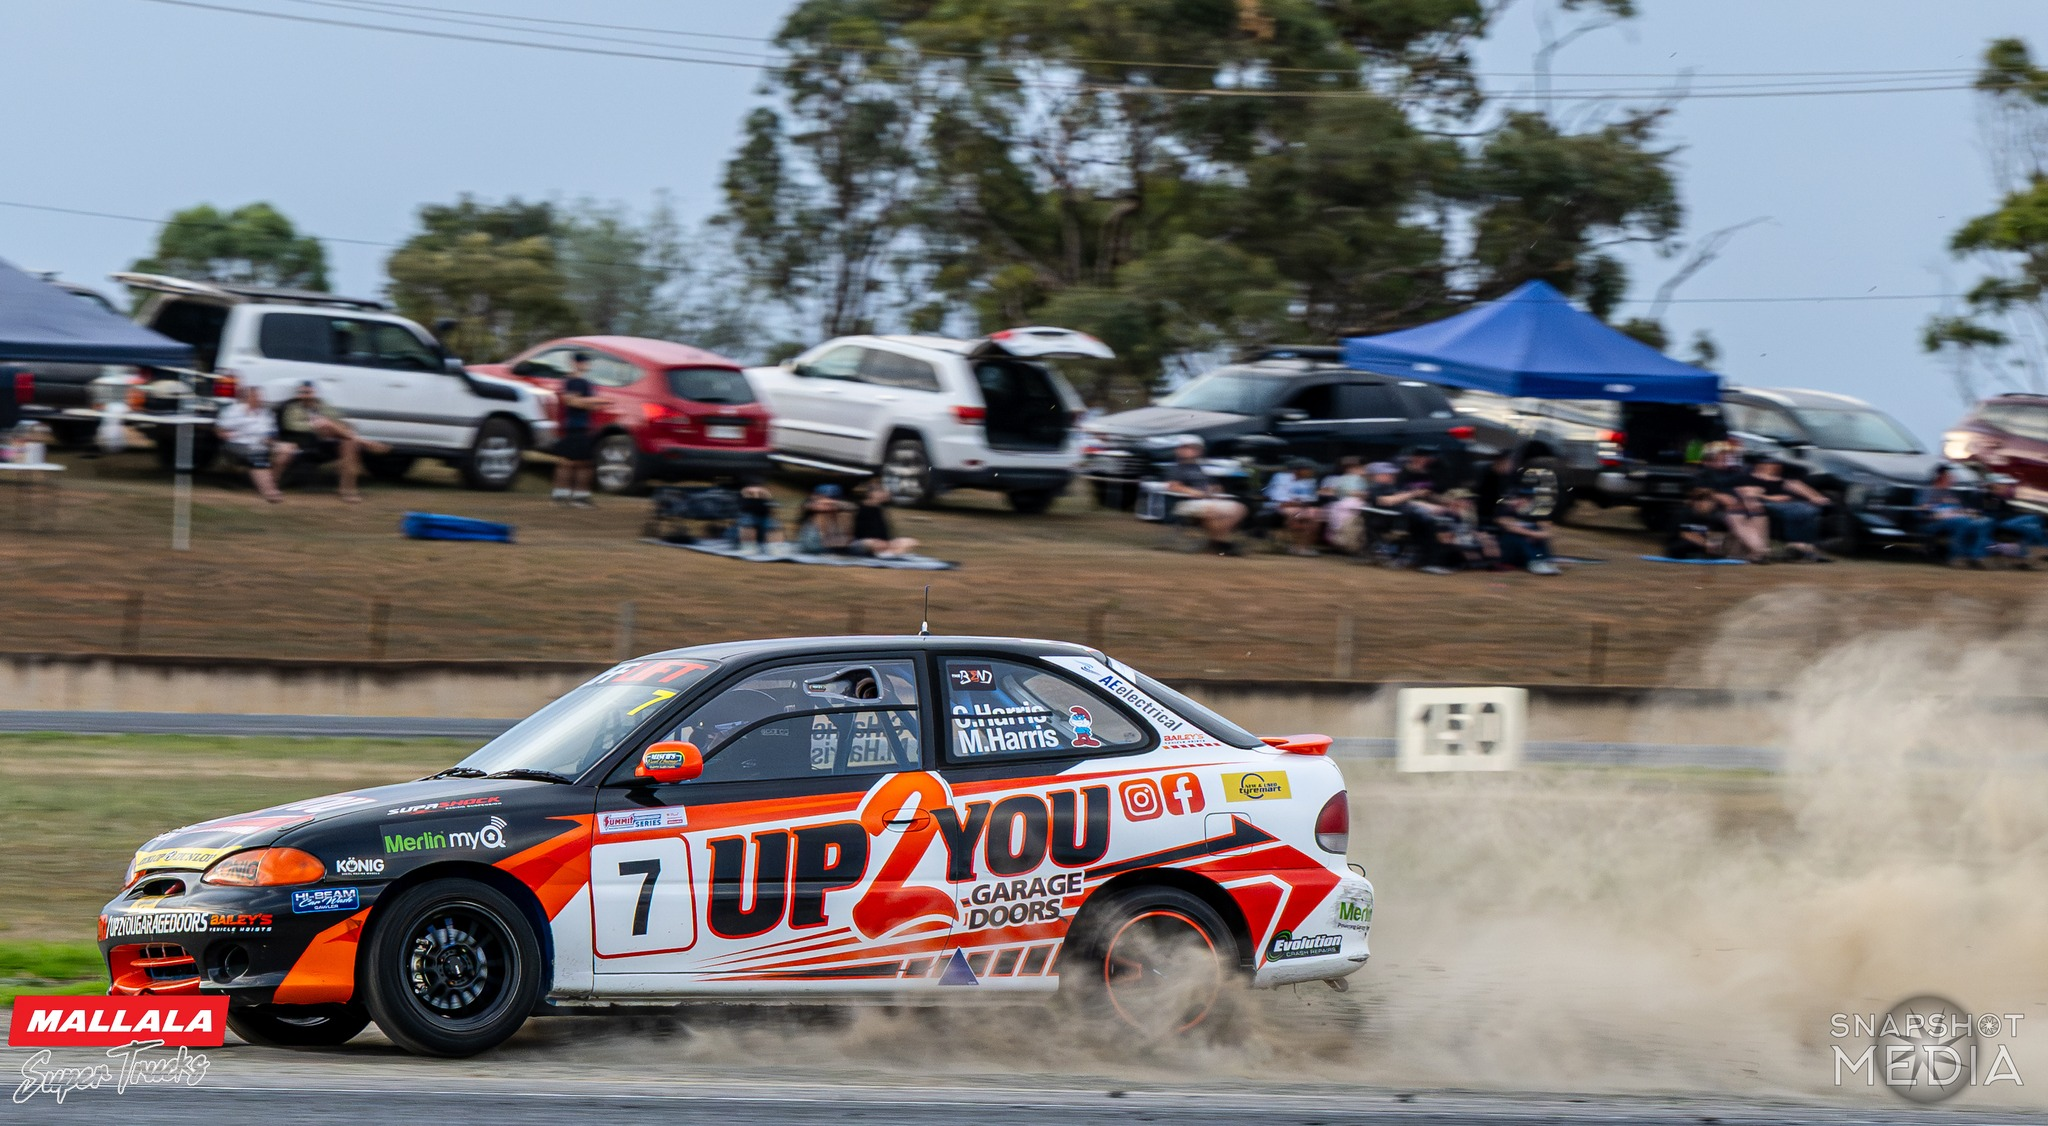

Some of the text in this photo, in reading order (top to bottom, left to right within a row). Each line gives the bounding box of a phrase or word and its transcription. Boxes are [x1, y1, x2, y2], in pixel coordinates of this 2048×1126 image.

[627, 689, 677, 716] 7
[1099, 675, 1183, 732] AEelectrical
[957, 725, 1060, 754] M.Harris
[1416, 702, 1506, 756] 150
[1239, 786, 1282, 795] tyremart
[387, 796, 500, 816] SUPASHOCK
[635, 819, 661, 828] SERIES
[384, 831, 447, 853] Merlin
[336, 856, 385, 874] KÖNIG
[295, 889, 356, 902] HI-BEAM
[617, 858, 661, 937] 7
[971, 872, 1083, 906] GARAGE
[210, 912, 273, 926] BAILEY'S
[968, 898, 1062, 931] DOORS
[1273, 935, 1342, 953] Evolution
[1310, 947, 1337, 955] REPAIRS
